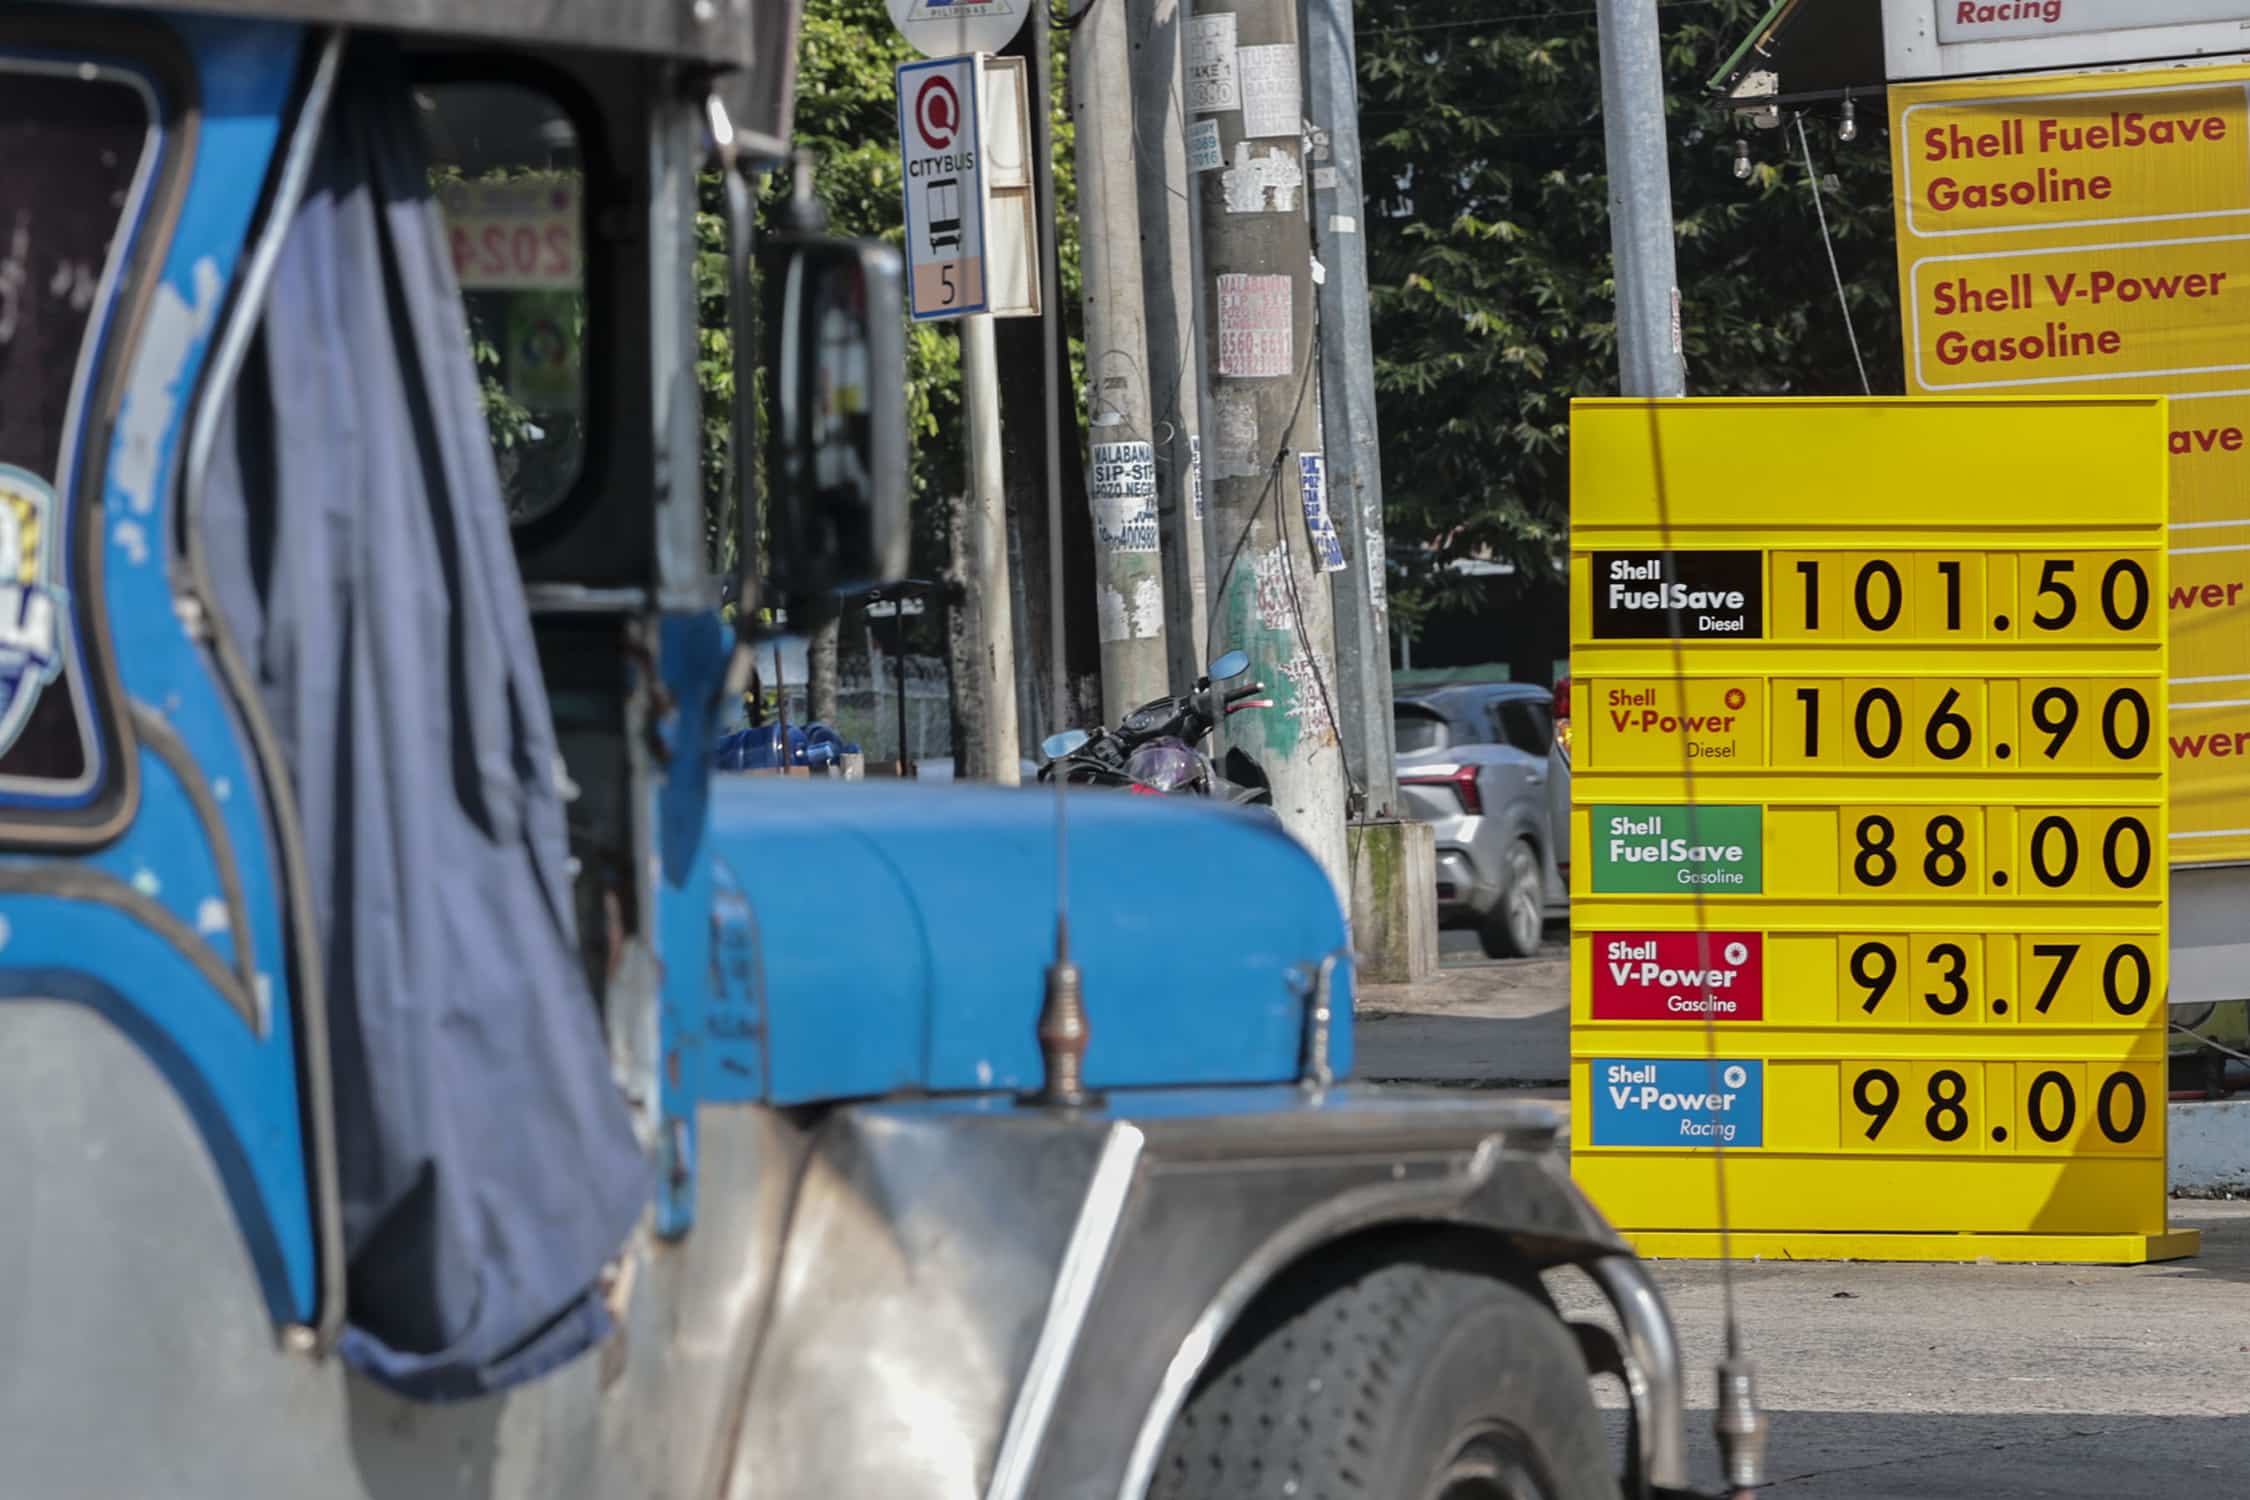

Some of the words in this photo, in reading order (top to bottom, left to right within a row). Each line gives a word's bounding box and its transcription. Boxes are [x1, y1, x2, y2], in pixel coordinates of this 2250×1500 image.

[1956, 0, 2062, 24] Racing
[1925, 119, 2024, 161] Shell
[2039, 112, 2226, 152] FuelSave
[910, 151, 974, 177] CITYBUS
[1927, 167, 2112, 211] Gasoline
[941, 264, 955, 305] 5
[1934, 273, 2032, 315] Shell
[2046, 270, 2226, 306] V-Power
[1936, 322, 2120, 365] Gasoline
[1609, 559, 1660, 581] Shell
[1609, 584, 1744, 610] FuelSave
[1796, 559, 2150, 632] 101.50
[1699, 615, 1744, 631] Diesel
[1608, 689, 1656, 708] Shell
[1610, 711, 1735, 734] V-Power
[1797, 687, 2150, 761] 106.90
[1686, 741, 1736, 759] Diesel
[1610, 816, 1661, 836] Shell
[1610, 838, 1743, 863] FuelSave
[1854, 815, 2151, 890] 88.00
[1677, 868, 1744, 885] Gasoline
[1608, 942, 1657, 961] Shell
[1608, 963, 1737, 988] V-Power
[1850, 942, 2151, 1016] 93.70
[1667, 996, 1737, 1014] Gasoline
[1608, 1066, 1656, 1084] Shell
[1608, 1087, 1736, 1111] V-Power
[1852, 1069, 2147, 1144] 98.00
[1680, 1119, 1736, 1141] Racing
